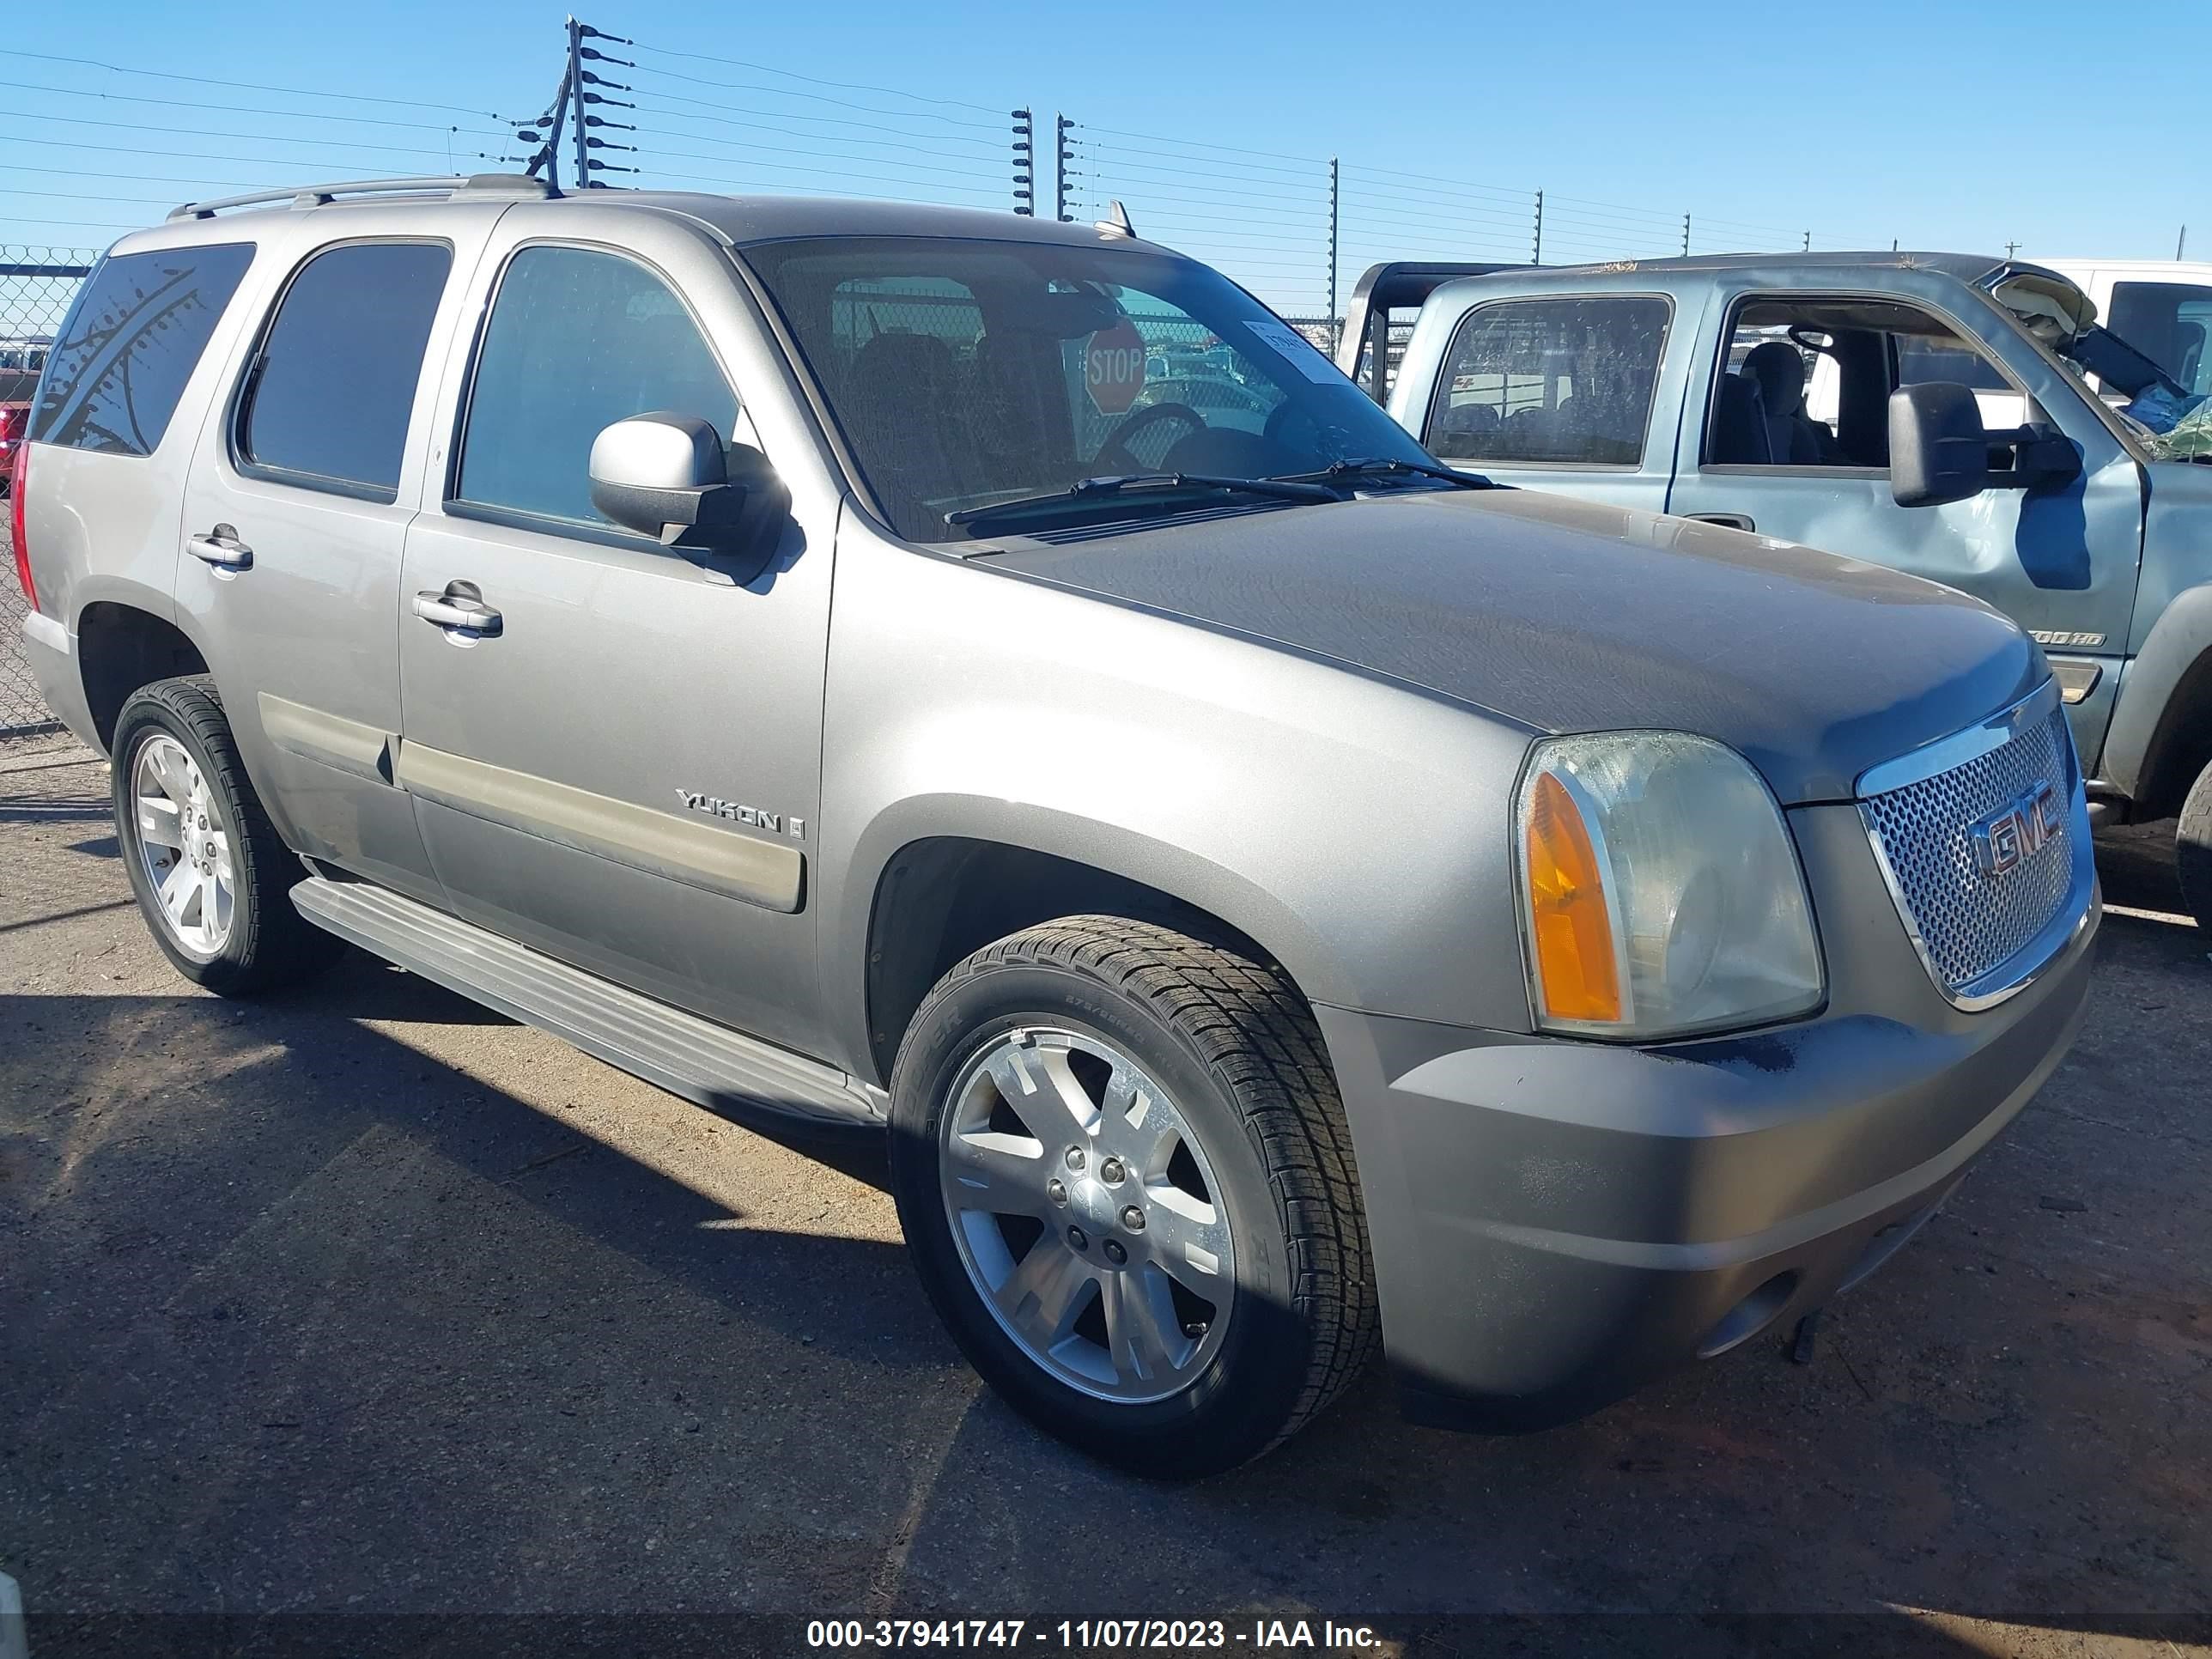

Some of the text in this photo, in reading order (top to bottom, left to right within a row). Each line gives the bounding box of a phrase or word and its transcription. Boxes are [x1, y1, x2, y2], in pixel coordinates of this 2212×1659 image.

[1090, 348, 1142, 386] STOP
[674, 787, 782, 833] YUKON
[1984, 782, 2060, 874] GMC
